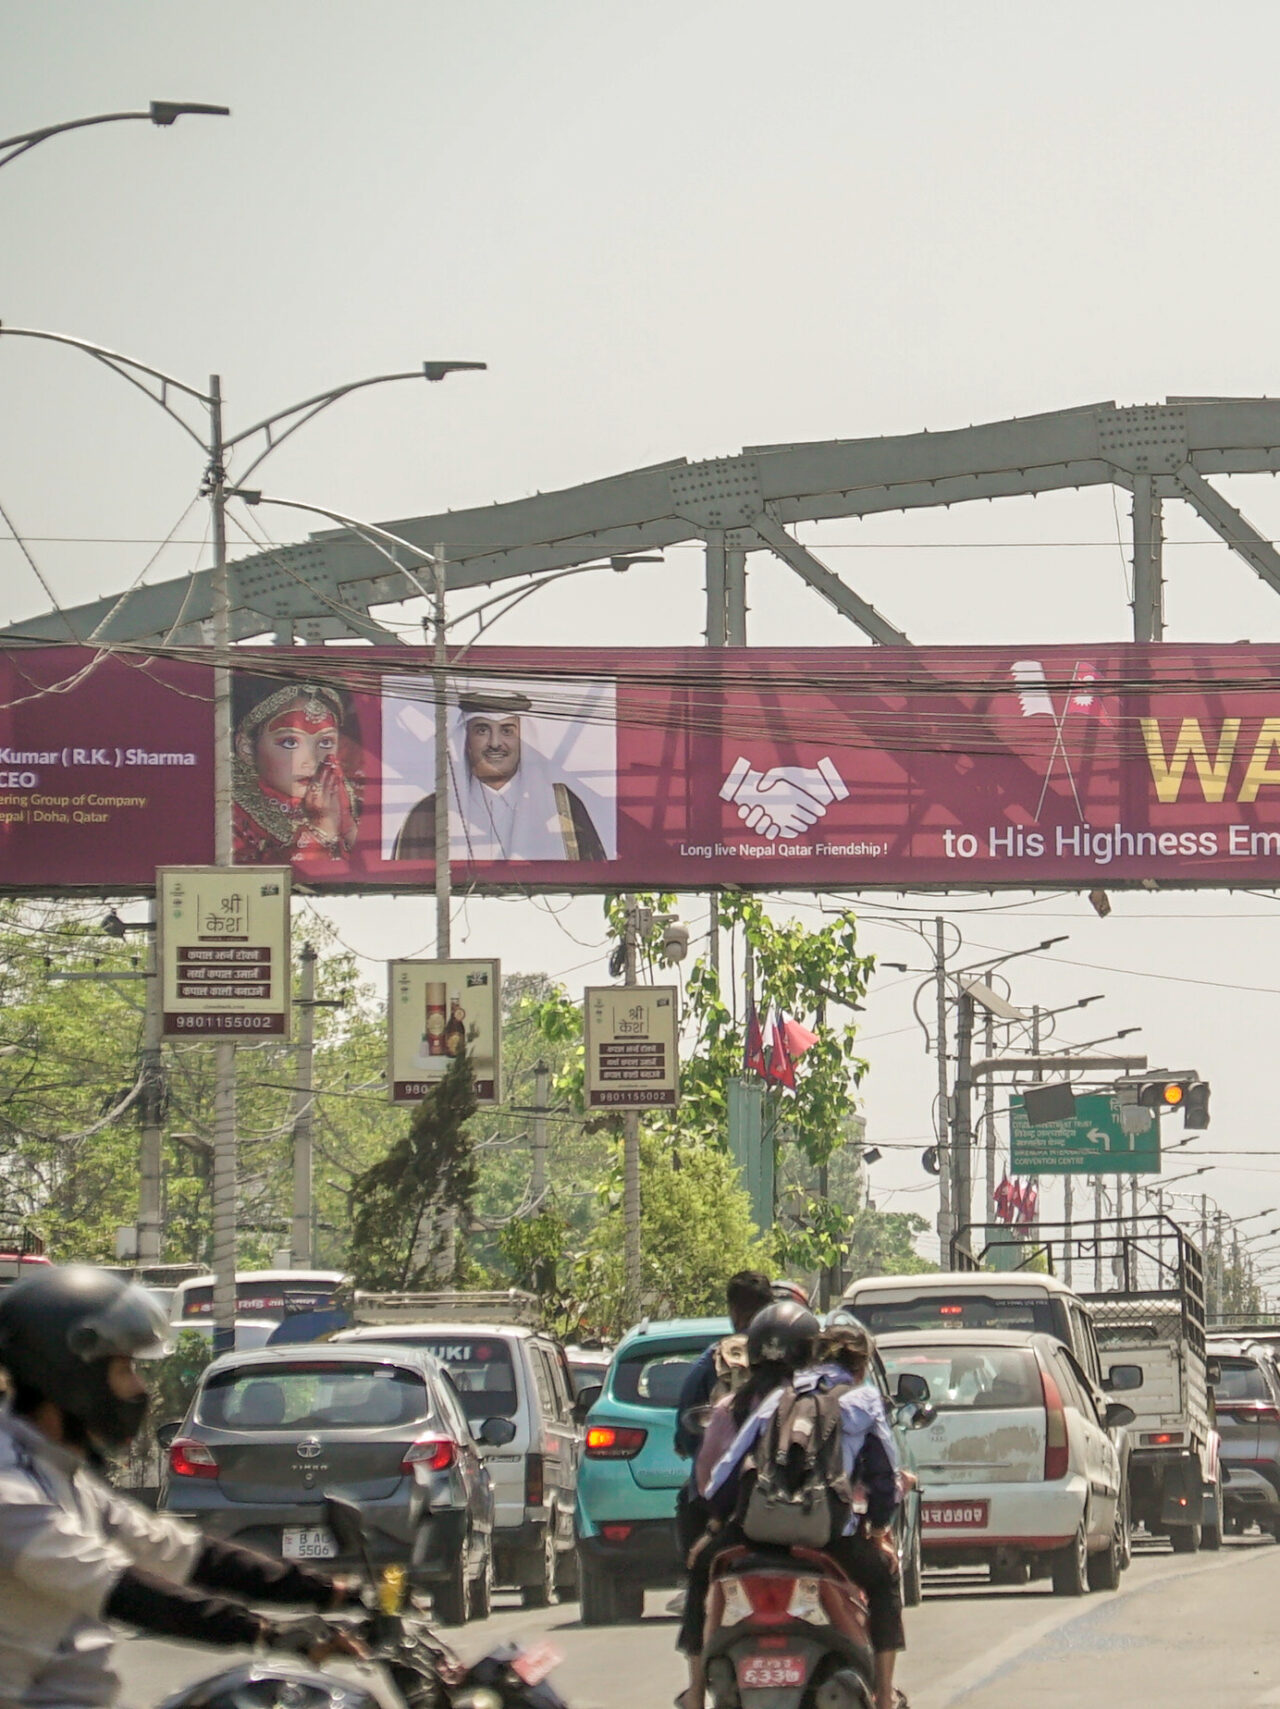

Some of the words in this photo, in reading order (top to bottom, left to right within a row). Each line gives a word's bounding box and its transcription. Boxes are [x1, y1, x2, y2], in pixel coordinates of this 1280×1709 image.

[0, 748, 58, 765] Kumar
[73, 749, 110, 765] R.K.
[125, 749, 196, 765] Sharma
[0, 772, 36, 788] CEO
[30, 794, 69, 808] Group
[72, 794, 86, 805] of
[87, 794, 146, 808] Company
[33, 811, 70, 824] Doha,
[73, 811, 109, 824] Qatar
[680, 844, 712, 859] Long
[715, 843, 737, 856] live
[740, 843, 776, 859] Nepal
[778, 843, 813, 858] Qatar
[815, 842, 881, 859] Friendship
[942, 829, 978, 858] to
[989, 825, 1045, 858] His
[1056, 824, 1218, 864] Highness
[176, 1016, 272, 1028] 9801155002
[600, 1091, 666, 1101] 9801155002
[299, 1544, 329, 1556] 5506
